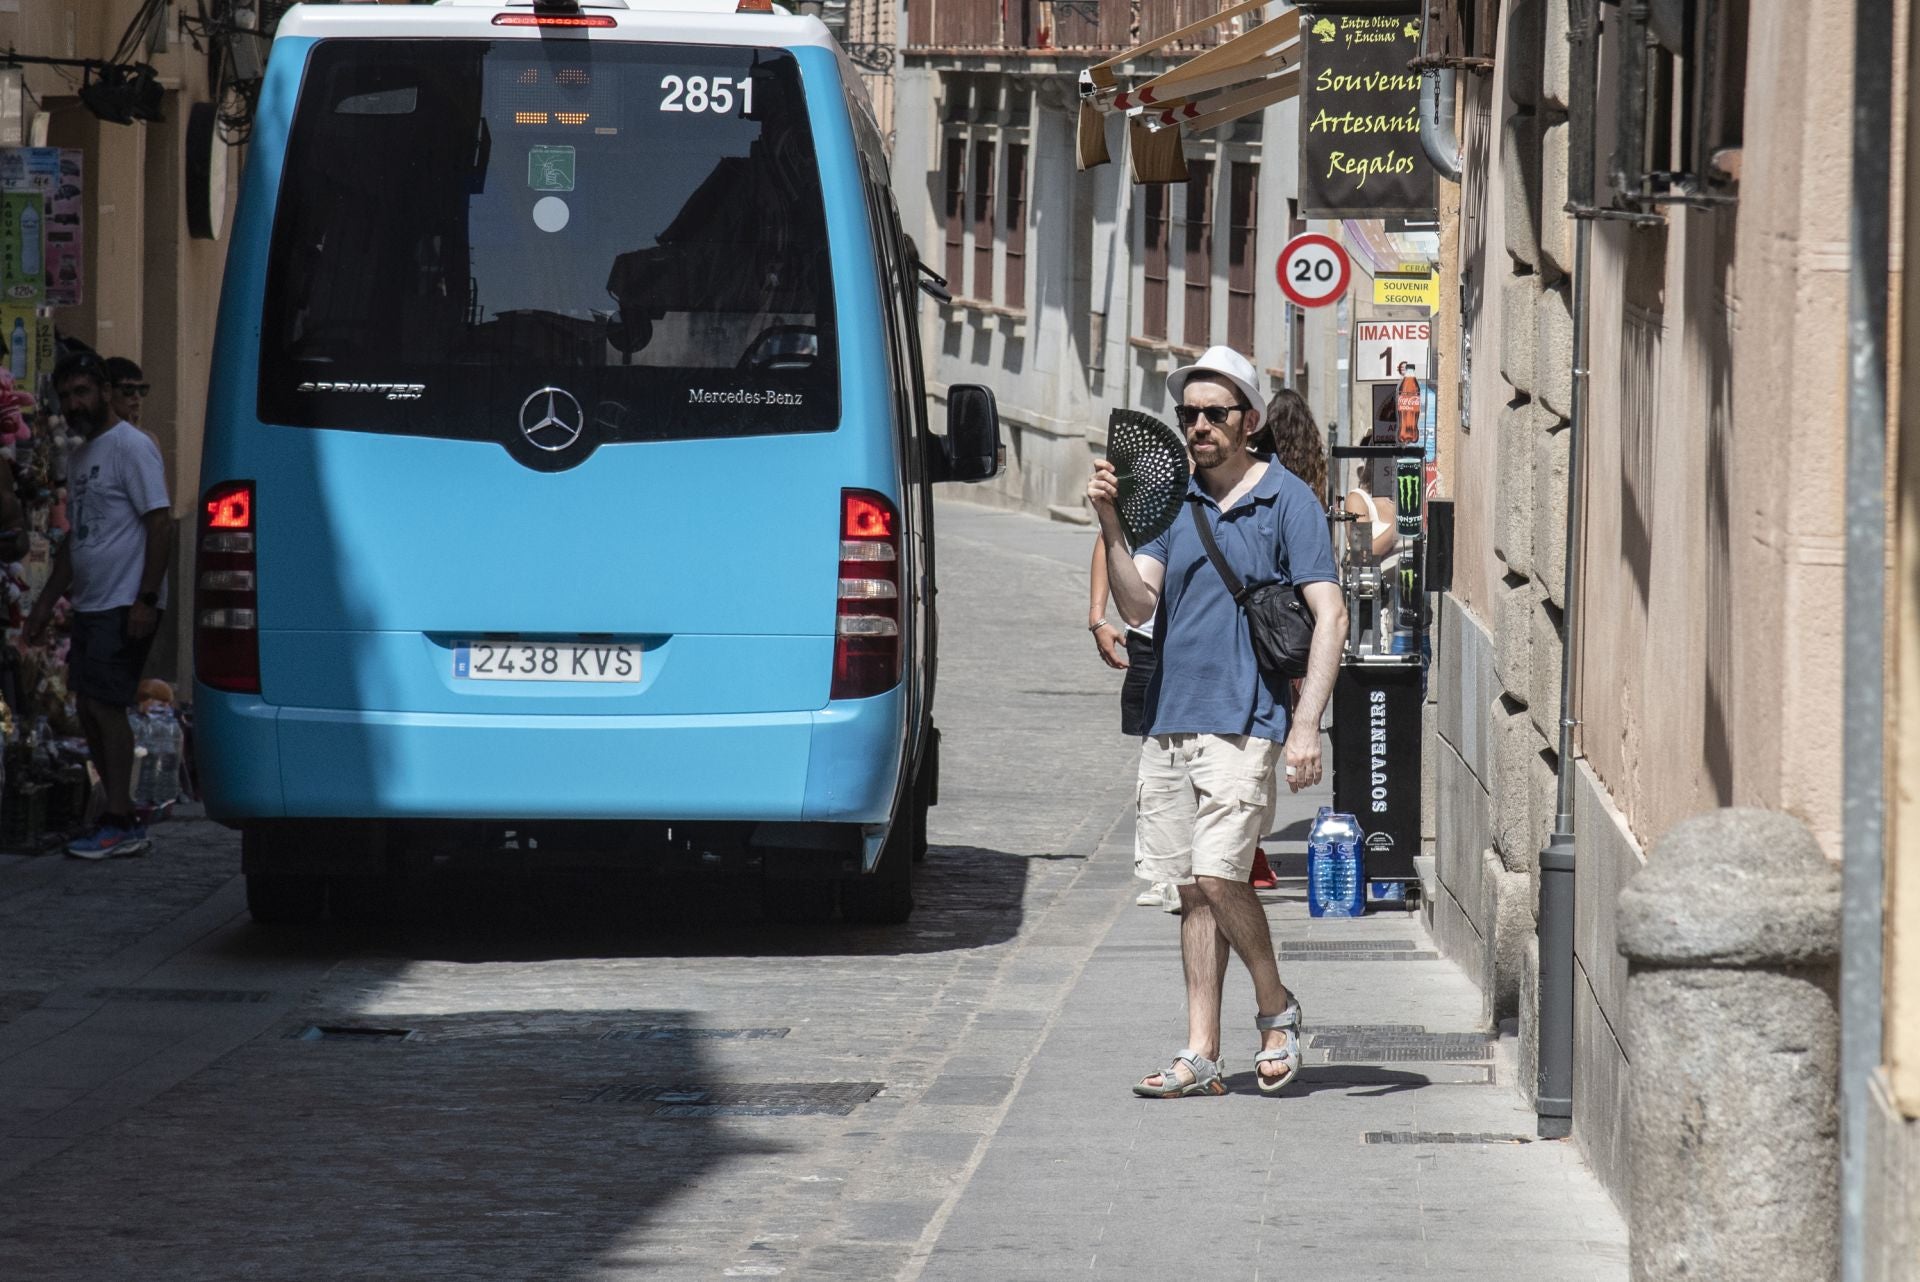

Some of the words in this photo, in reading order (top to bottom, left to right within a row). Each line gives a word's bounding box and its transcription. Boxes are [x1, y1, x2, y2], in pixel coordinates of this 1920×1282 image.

[1341, 16, 1370, 30] Entre
[1371, 16, 1400, 28] Olivos
[1345, 33, 1353, 50] y
[1354, 30, 1396, 43] Encinas
[660, 74, 753, 114] 2851
[1326, 150, 1414, 189] Regalos
[1294, 258, 1334, 282] 20
[1384, 282, 1429, 291] SOUVENIR
[1385, 295, 1423, 303] SEGOVIA
[1360, 324, 1430, 341] IMANES
[297, 382, 425, 393] SPRINTER
[689, 389, 803, 405] Mercedes-Benz
[459, 663, 466, 671] E
[475, 645, 558, 674] 2438
[572, 646, 632, 676] KVS
[1370, 690, 1387, 813] SOUVENIRS
